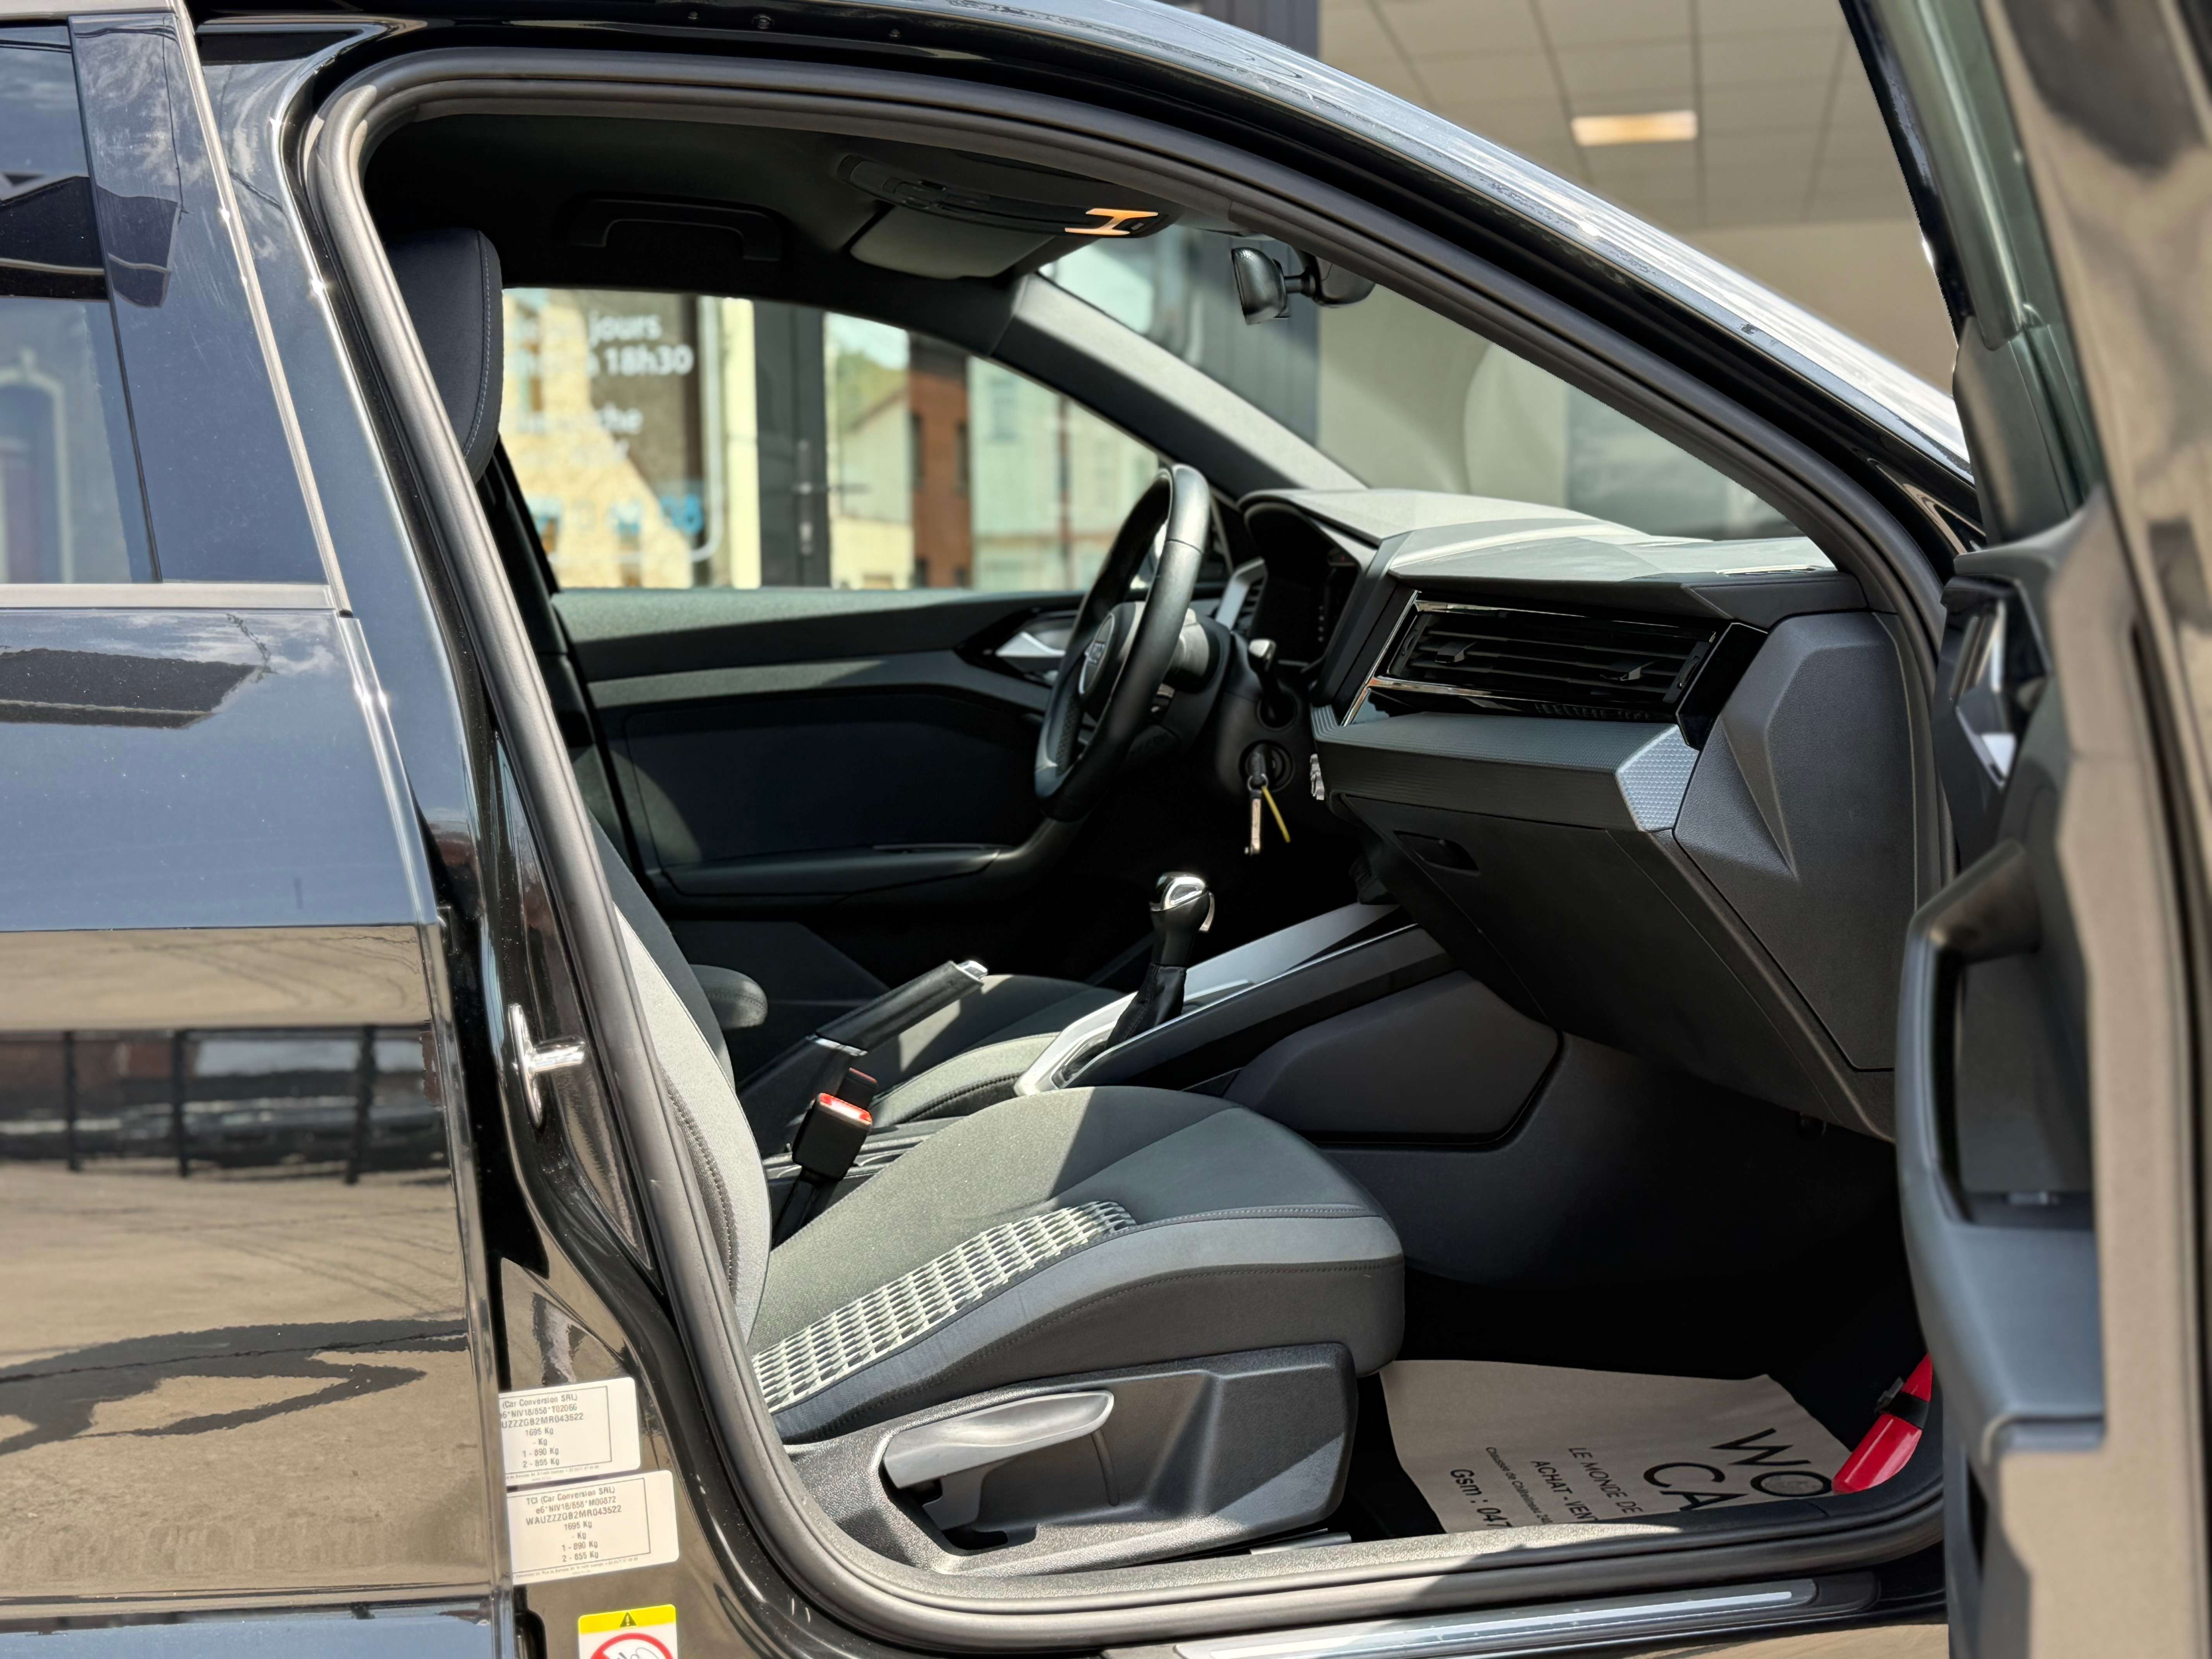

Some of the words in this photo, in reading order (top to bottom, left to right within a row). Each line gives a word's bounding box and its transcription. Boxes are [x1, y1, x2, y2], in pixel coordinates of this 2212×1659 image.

[604, 344, 694, 377] 18h30
[502, 1400, 516, 1409] (Car
[519, 1397, 558, 1407] Conversion
[534, 1448, 547, 1456] 890
[550, 1447, 559, 1455] Kg
[535, 1458, 548, 1467] 855
[1709, 1428, 1834, 1497] WO
[1450, 1469, 1482, 1496] Gsm
[1530, 1460, 1572, 1494] ACHAT
[1569, 1447, 1593, 1460] LE
[1581, 1462, 1628, 1499] MONDE
[1615, 1500, 1644, 1514] DE
[1643, 1462, 1748, 1511] CA
[541, 1495, 555, 1504] (Car
[557, 1490, 596, 1501] Conversion
[564, 1522, 580, 1530] 1695
[583, 1520, 592, 1528] Kg
[577, 1531, 586, 1539] Kg
[574, 1541, 586, 1550] 890
[589, 1540, 598, 1548] Kg
